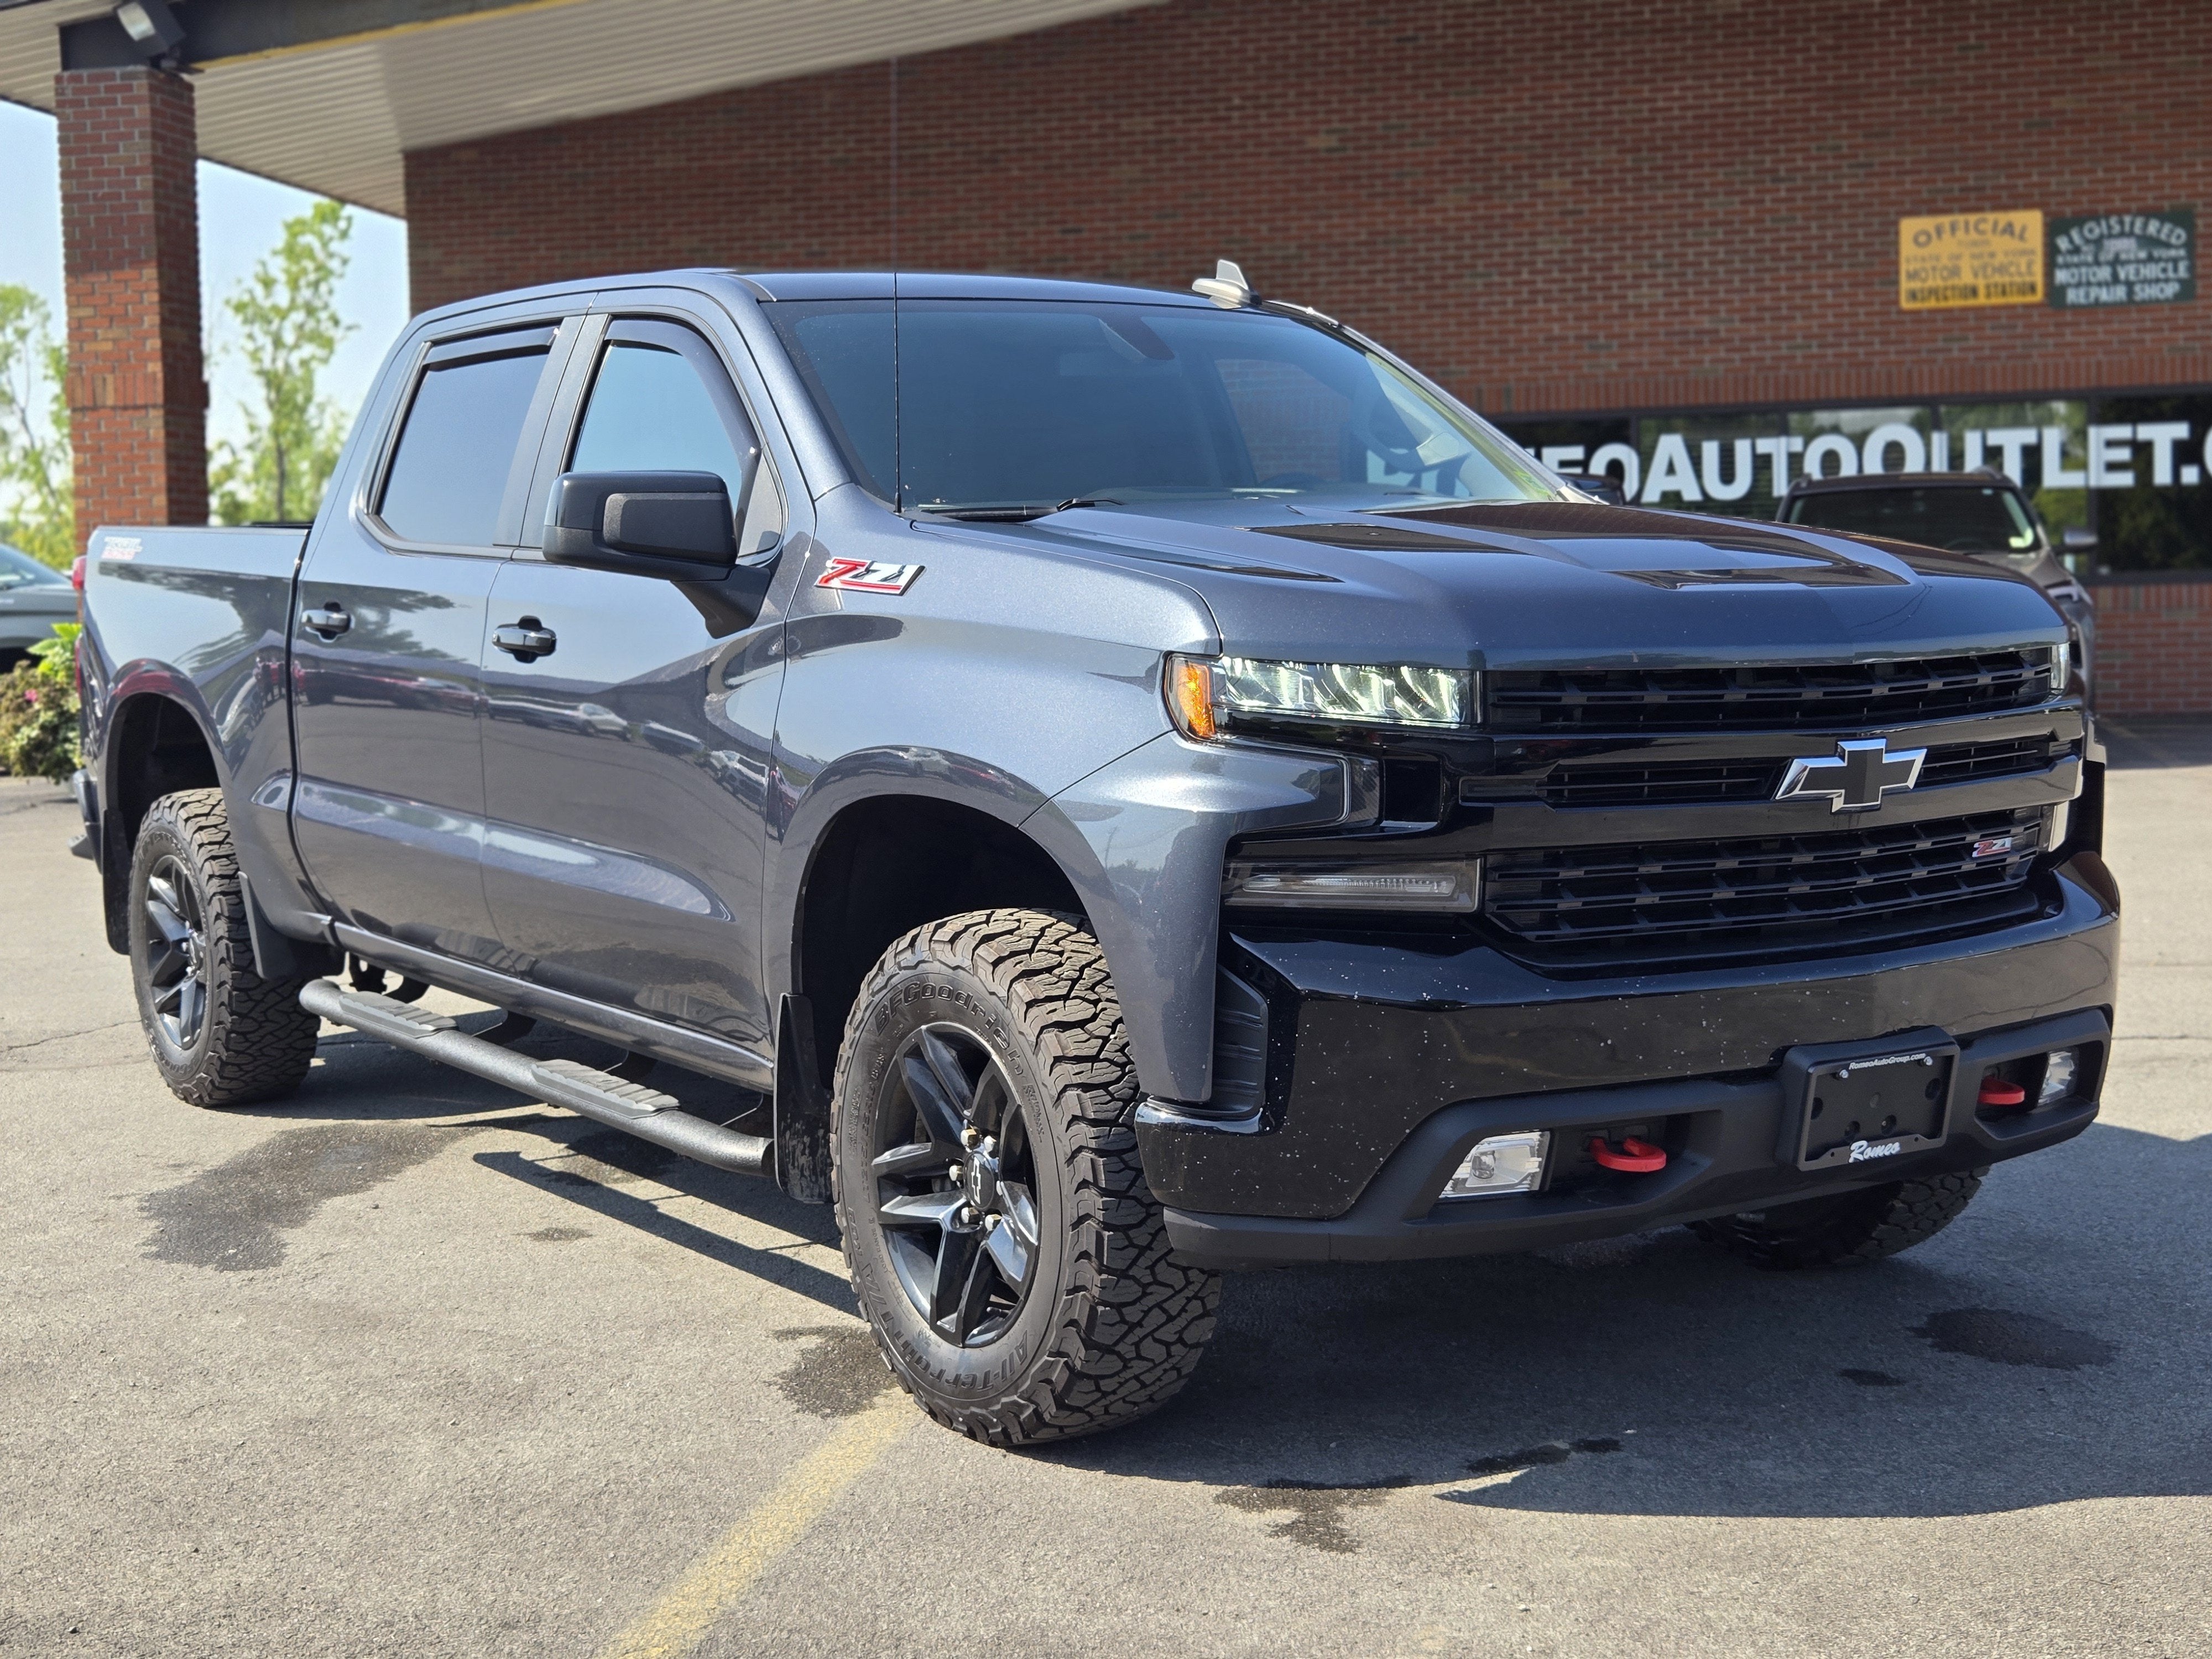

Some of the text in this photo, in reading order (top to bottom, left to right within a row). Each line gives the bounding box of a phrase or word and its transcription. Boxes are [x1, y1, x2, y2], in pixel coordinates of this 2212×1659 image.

[1912, 216, 2028, 248] OFFICIAL
[2054, 214, 2188, 253] REGISTERED
[1905, 259, 2035, 283] MOTOR VEHICLE
[2053, 259, 2190, 286] MOTOR VEHICLE
[1984, 280, 2037, 299] STATION
[2065, 280, 2182, 306] REPAIR SHOP
[814, 556, 927, 596] Z71
[1972, 837, 2012, 857] Z71
[874, 981, 1024, 1076] BFGoodrich
[1848, 1052, 1926, 1071] RomeoAutoGroup.com
[1848, 1140, 1901, 1164] Romeo
[893, 1329, 1029, 1393] All-Terrain
